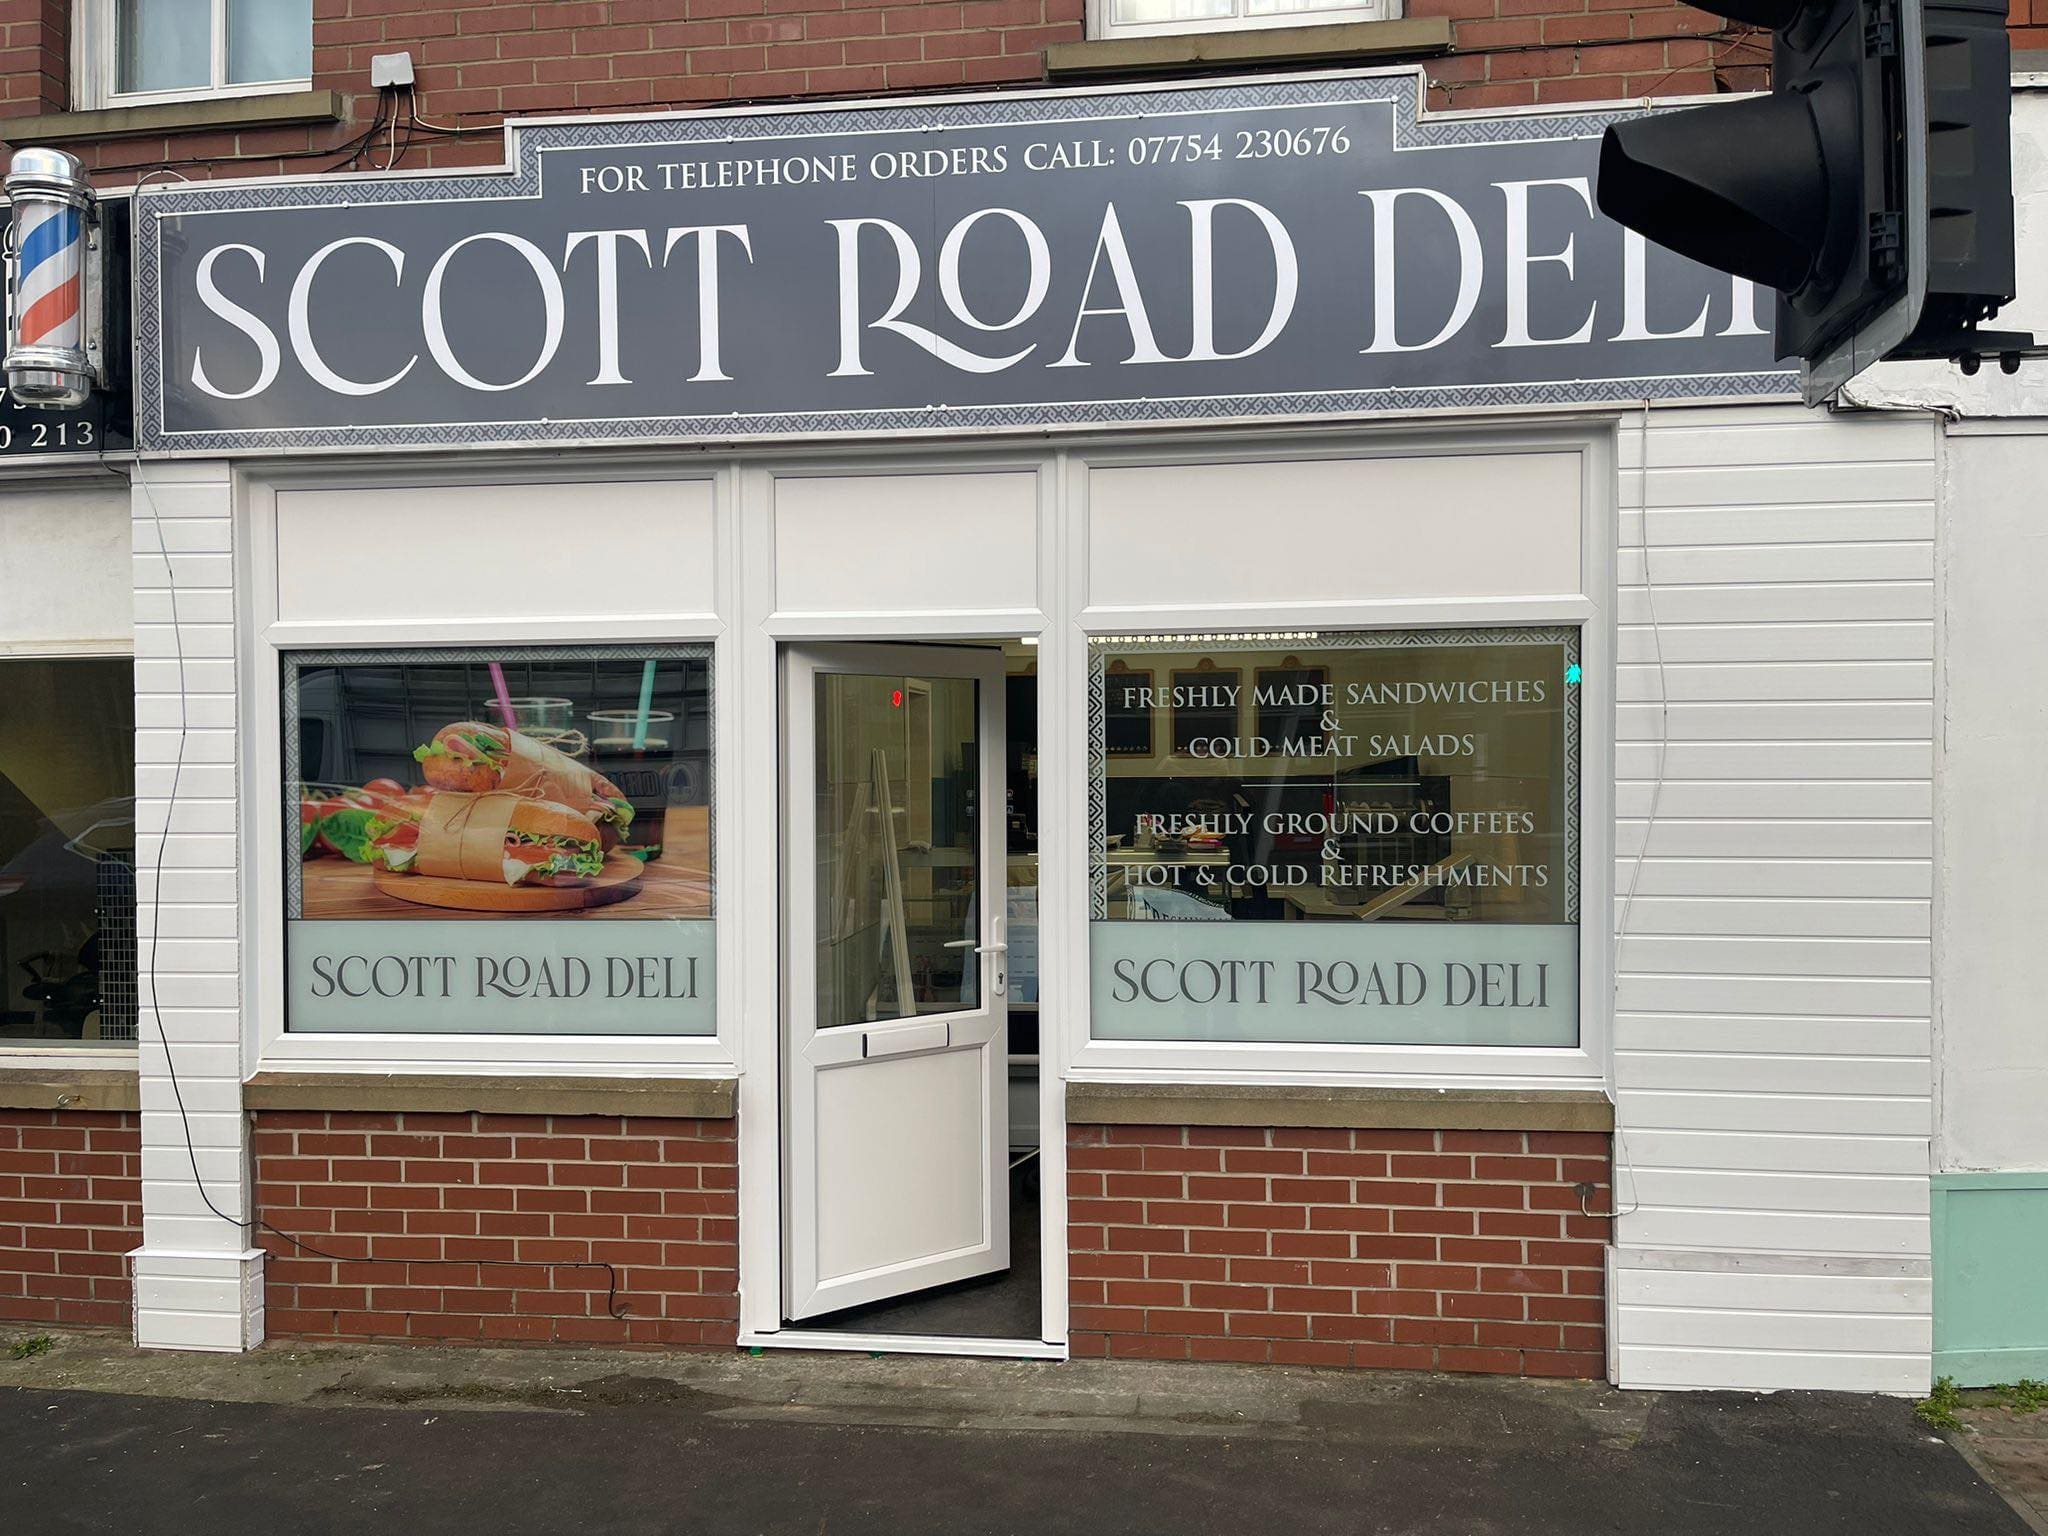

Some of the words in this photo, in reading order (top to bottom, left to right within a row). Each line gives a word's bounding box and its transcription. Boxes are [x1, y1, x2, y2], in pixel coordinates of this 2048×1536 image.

[580, 165, 649, 194] FOR
[657, 154, 858, 190] TELEPHONE
[869, 145, 1008, 180] ORDERS
[1023, 141, 1116, 171] CALL:
[1128, 132, 1223, 166] 07754
[1235, 126, 1351, 160] 230676
[190, 223, 754, 400] SCOTT
[824, 197, 1299, 374] ROAD
[31, 421, 94, 447] 213
[1123, 686, 1242, 708] FRESHLY
[1252, 684, 1335, 706] MADE
[1347, 680, 1546, 705] SANDWICHES
[1320, 710, 1343, 731] &
[1190, 737, 1270, 758] COLD
[1282, 736, 1359, 757] MEAT
[1369, 733, 1475, 757] SALADS
[1135, 813, 1255, 835] FRESHLY
[1263, 812, 1399, 835] GROUND
[1410, 811, 1535, 834] COFFEES
[1321, 838, 1345, 860] &
[1124, 864, 1186, 886] HOT
[1196, 864, 1218, 886] &
[1226, 864, 1308, 886] COLD
[1320, 864, 1549, 887] REFRESHMENTS
[311, 955, 457, 998] SCOTT
[475, 956, 591, 998] ROAD
[606, 957, 698, 999] DELI
[1112, 959, 1275, 1003] SCOTT
[1296, 961, 1427, 1007] ROAD
[1443, 963, 1550, 1008] DELI
